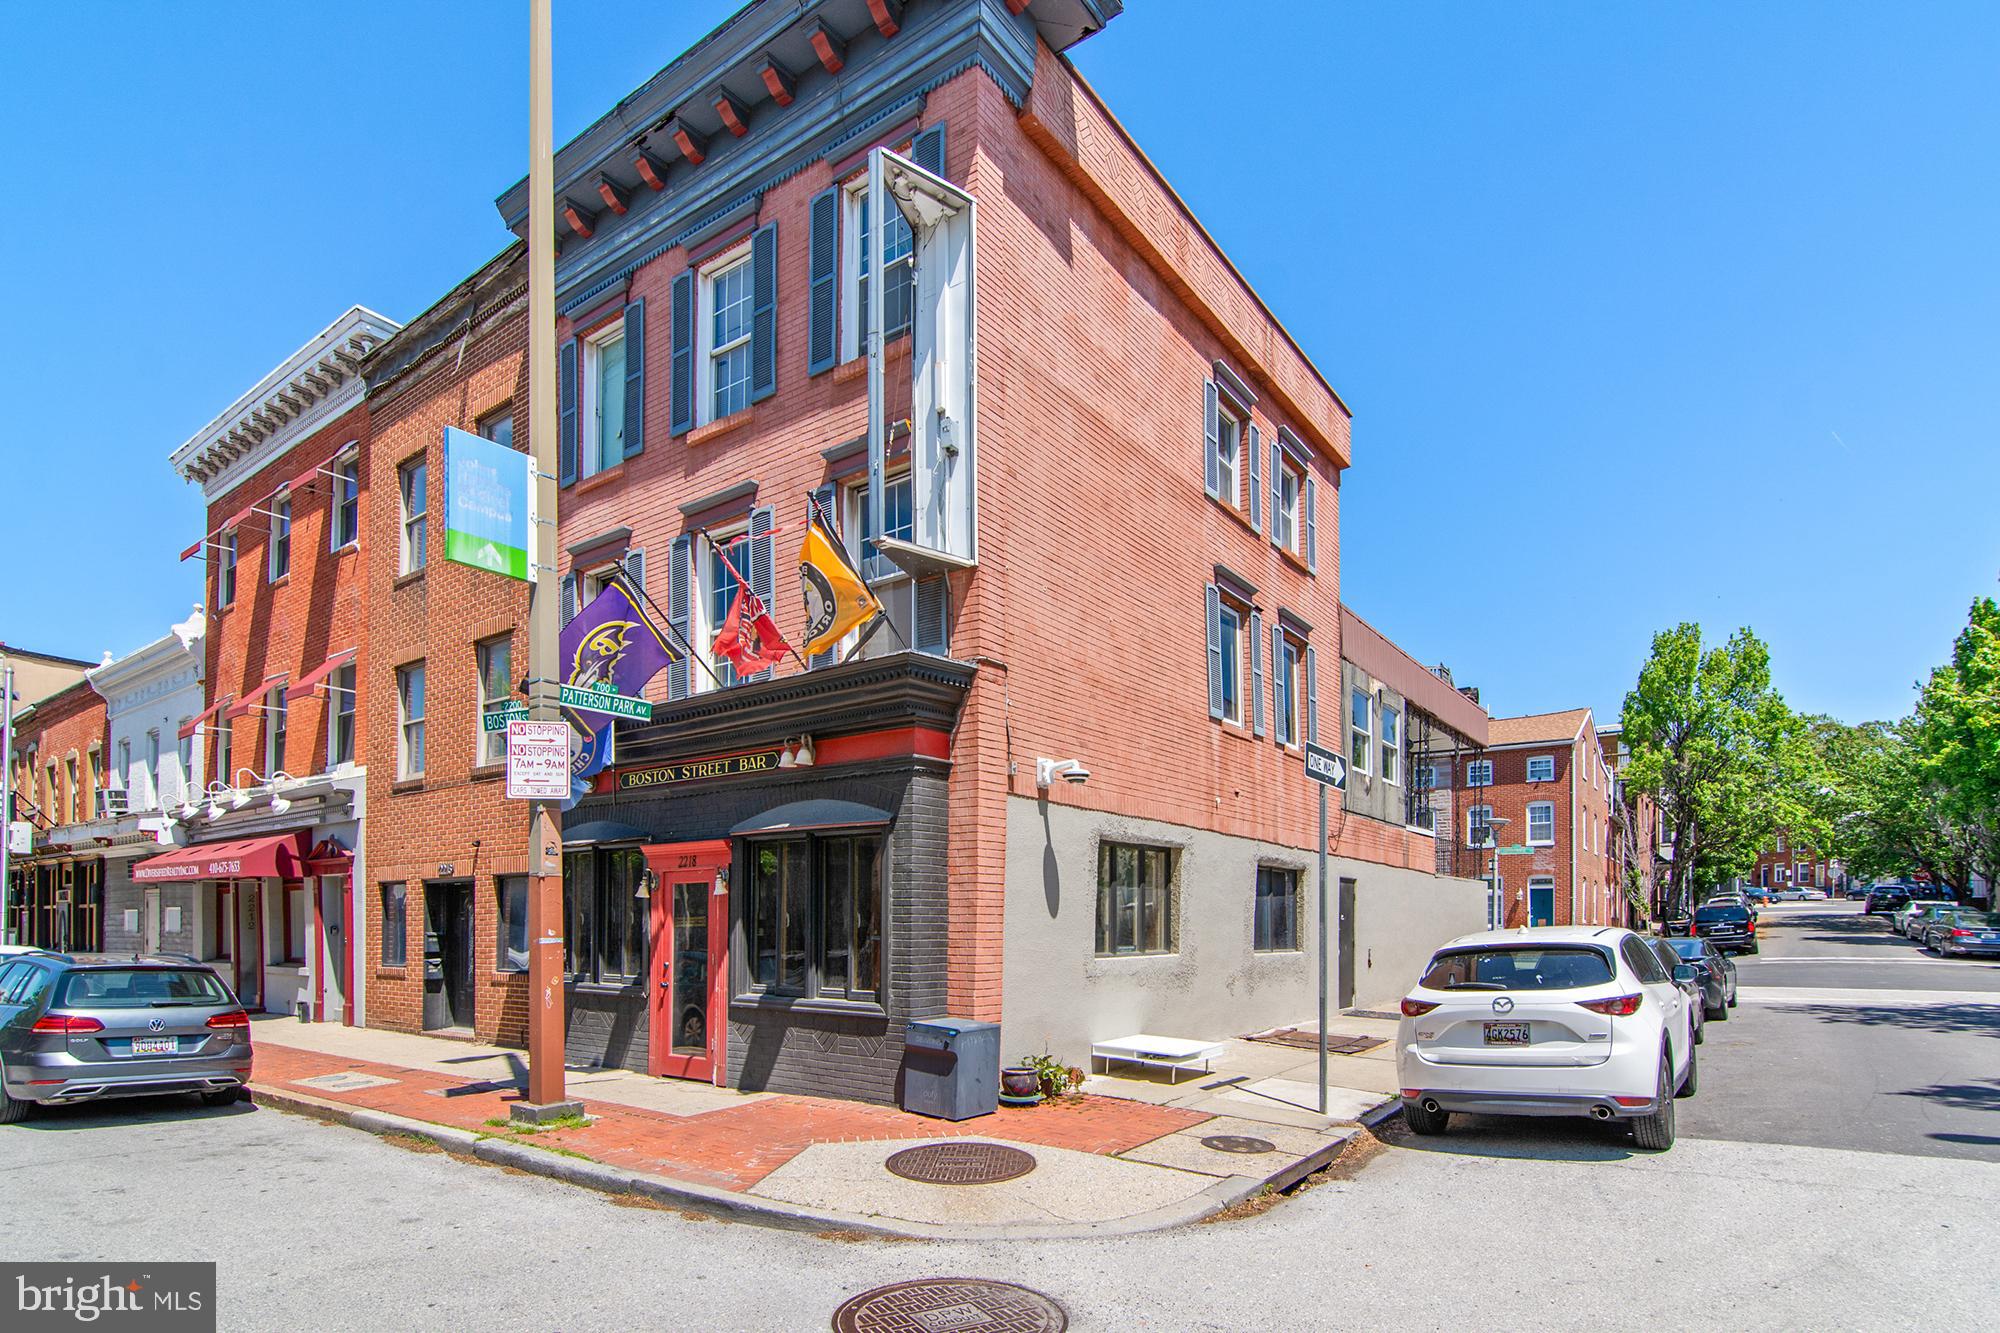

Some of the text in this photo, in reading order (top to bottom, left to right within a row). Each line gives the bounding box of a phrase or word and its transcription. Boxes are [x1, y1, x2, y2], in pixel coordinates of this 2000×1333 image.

[596, 682, 611, 693] 700
[503, 700, 522, 710] 2200
[562, 688, 611, 710] PATTERSON
[612, 699, 636, 715] PARK
[511, 724, 565, 736] NO STOPPING
[511, 745, 565, 757] NO STOPPING
[514, 758, 534, 769] 7AM
[544, 759, 565, 769] 9AM
[1310, 754, 1336, 776] ONE WAY
[628, 755, 767, 786] BOSTON STREET BAR
[513, 786, 527, 794] CARS
[678, 855, 697, 868] 2218
[929, 1313, 982, 1327] CONDUIT
